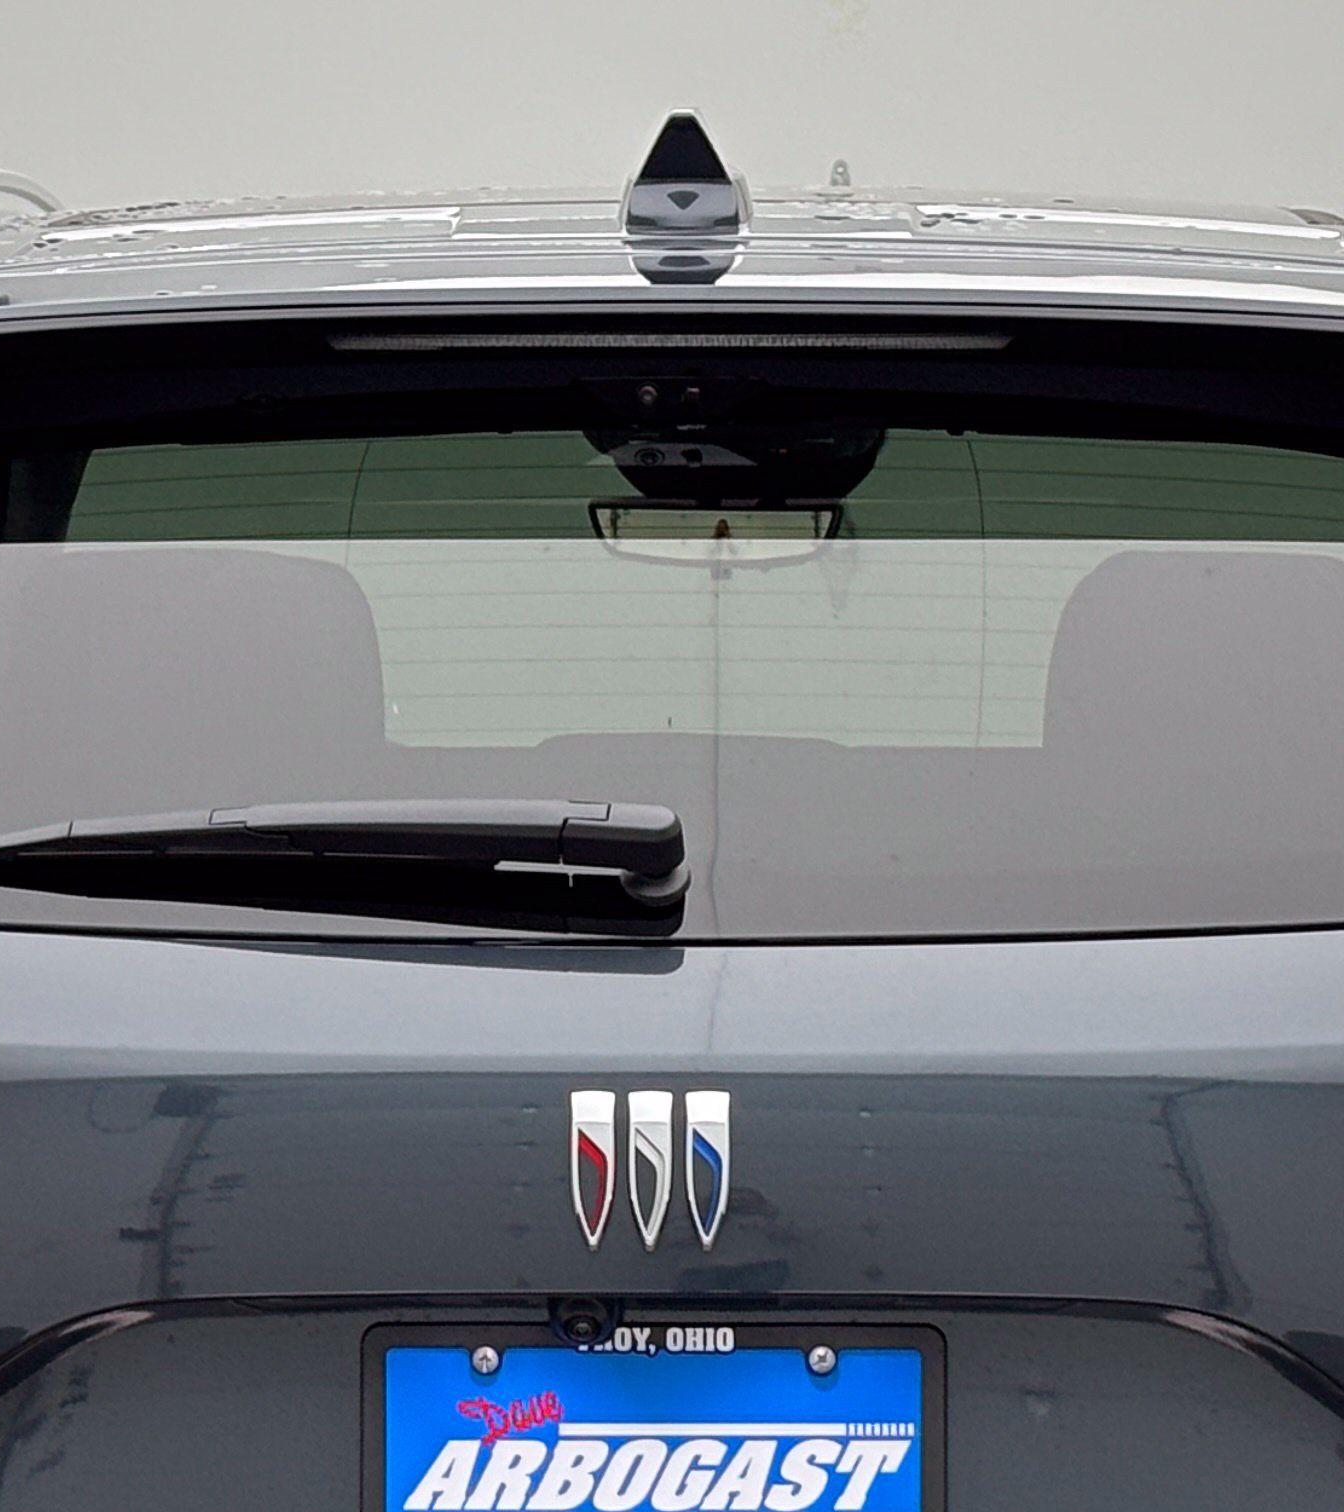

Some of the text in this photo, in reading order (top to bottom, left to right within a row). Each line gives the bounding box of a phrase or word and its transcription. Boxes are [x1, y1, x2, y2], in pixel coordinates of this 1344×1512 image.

[666, 1327, 735, 1352] OHIO
[458, 1391, 562, 1445] Dave
[402, 1440, 910, 1511] ARBOGAST
